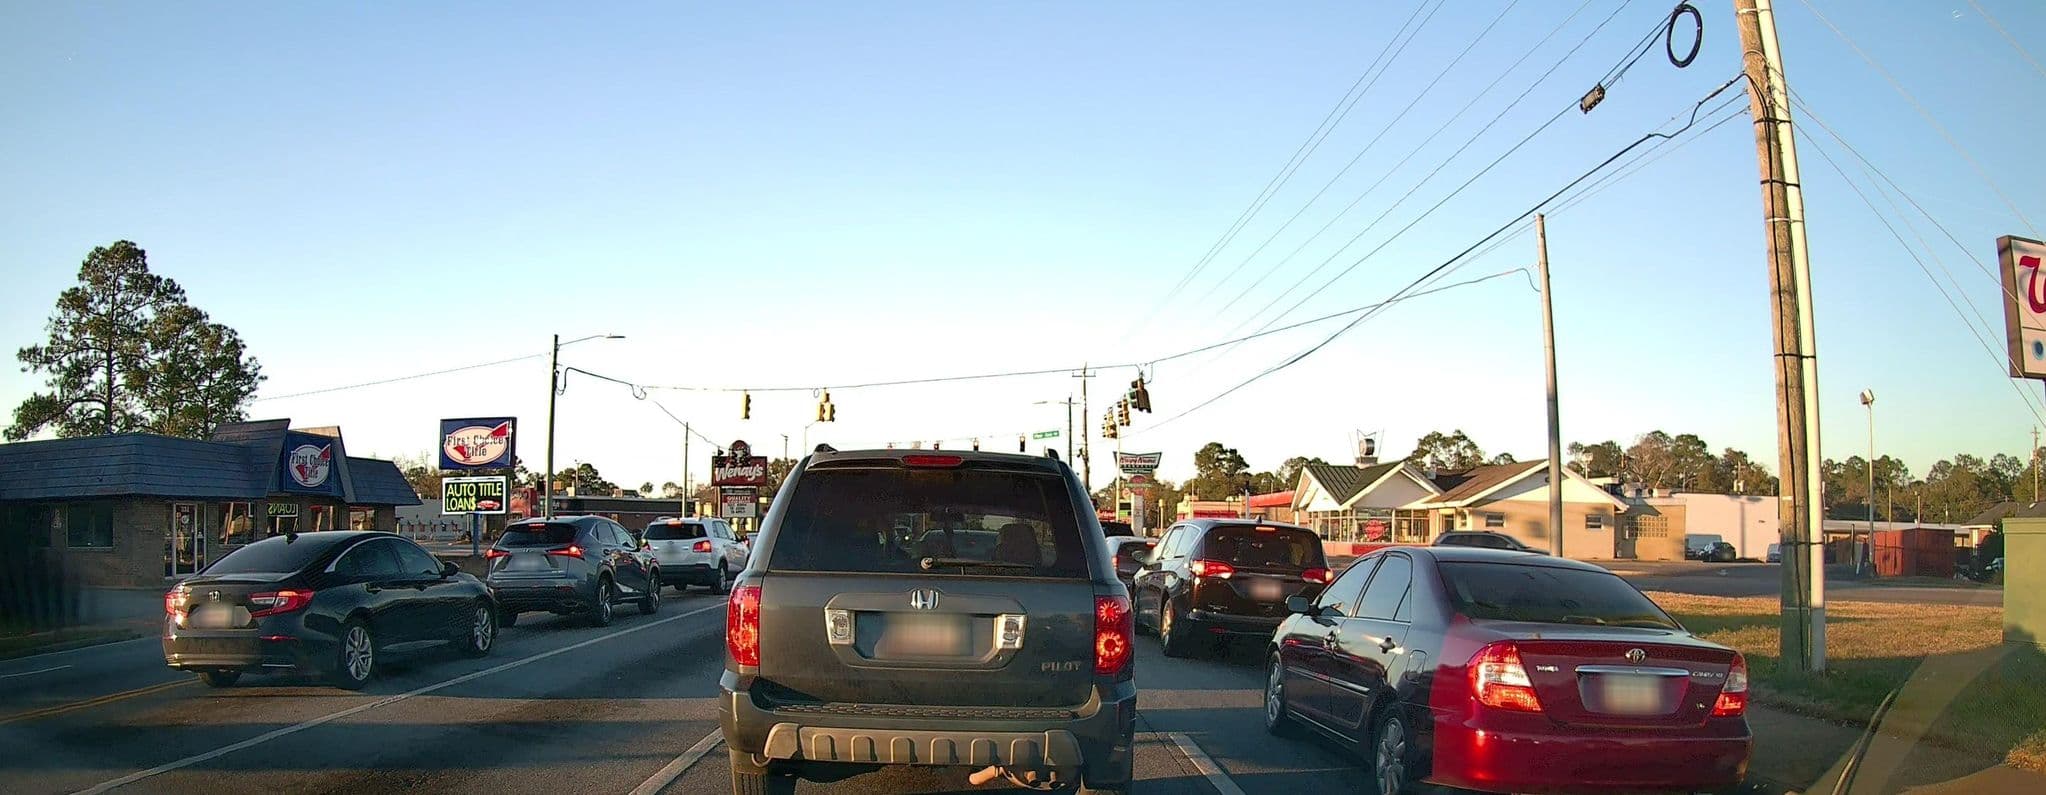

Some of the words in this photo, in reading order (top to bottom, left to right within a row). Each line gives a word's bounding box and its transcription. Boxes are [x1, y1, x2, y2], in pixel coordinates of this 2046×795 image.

[447, 435, 470, 446] First
[473, 434, 504, 446] Choice
[466, 446, 487, 457] Title
[291, 452, 308, 465] First
[715, 463, 764, 482] Wendy's
[446, 483, 477, 497] AUTO
[479, 482, 503, 497] TITLE
[1041, 661, 1081, 671] PILOT
